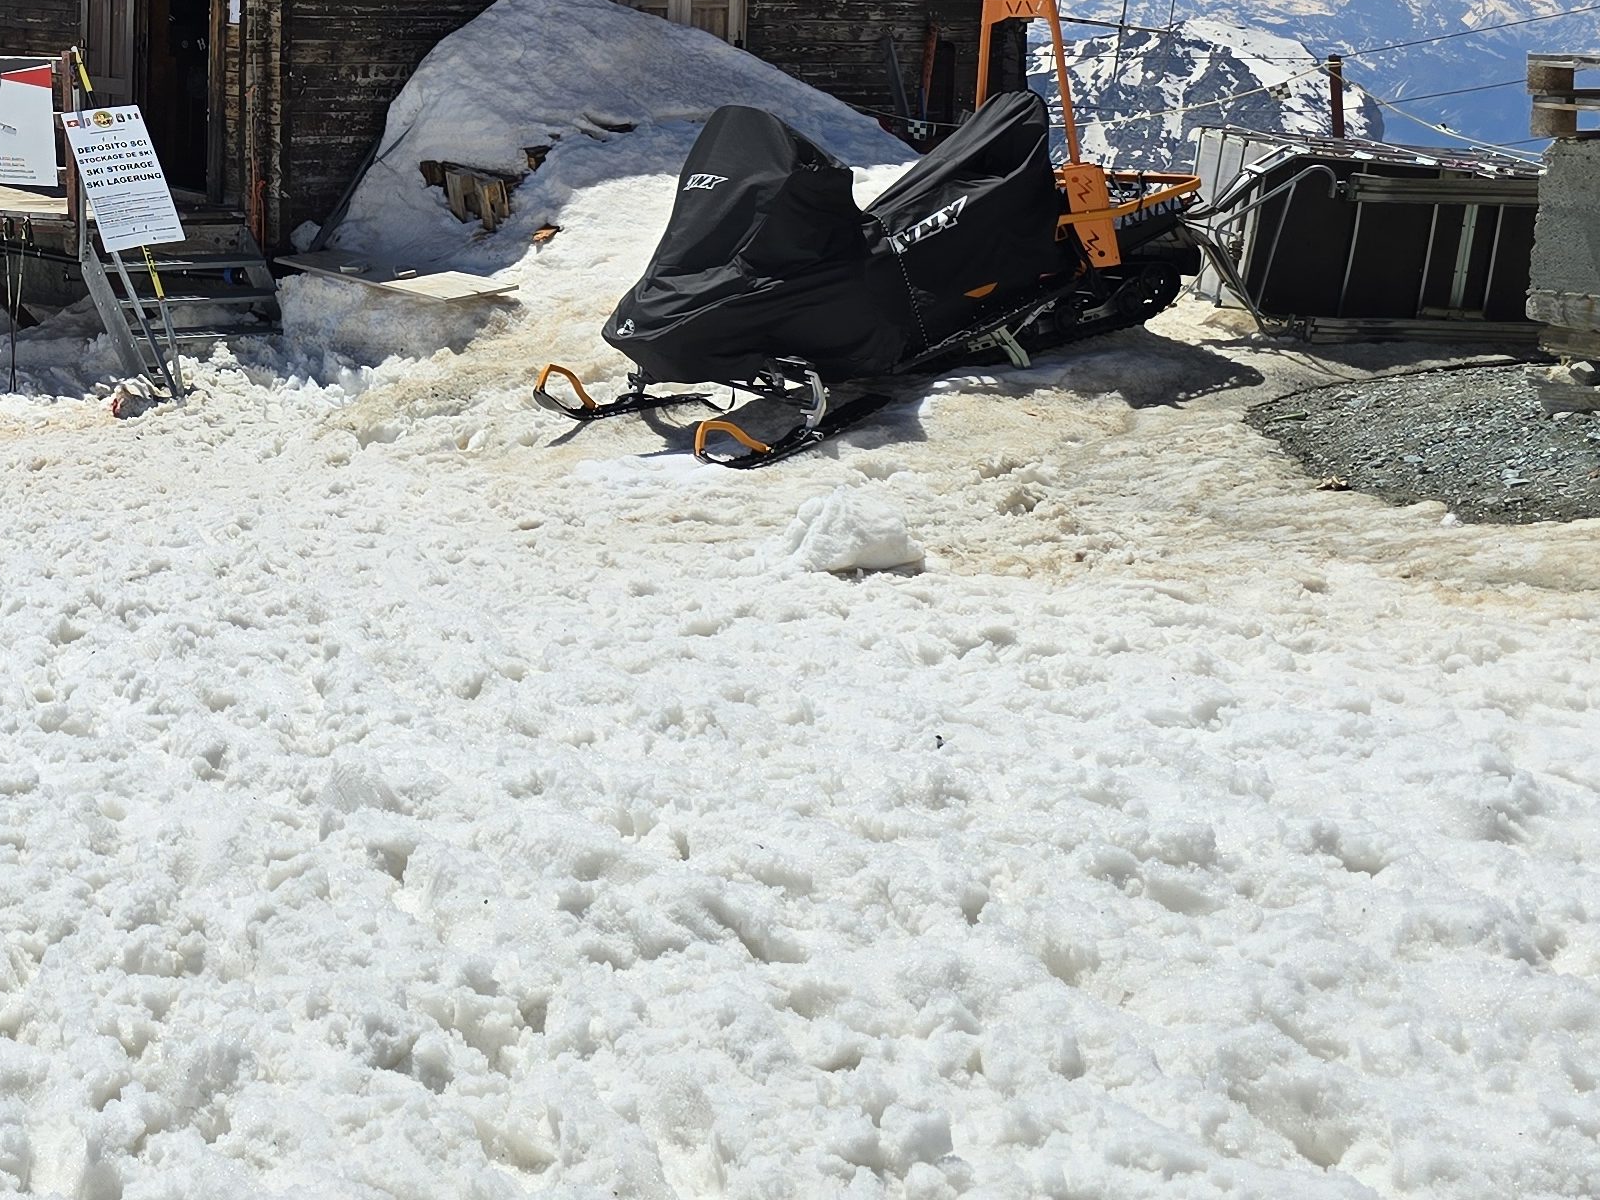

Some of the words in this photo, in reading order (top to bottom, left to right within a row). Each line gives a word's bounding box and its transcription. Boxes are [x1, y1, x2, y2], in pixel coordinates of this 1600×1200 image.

[77, 141, 128, 155] DEPOSITO
[130, 139, 148, 147] SCI
[79, 153, 124, 165] STOCKAGE
[86, 167, 104, 177] SKI
[106, 161, 155, 173] STORAGE
[86, 180, 104, 189] SKI
[106, 172, 162, 186] LAGERUNG
